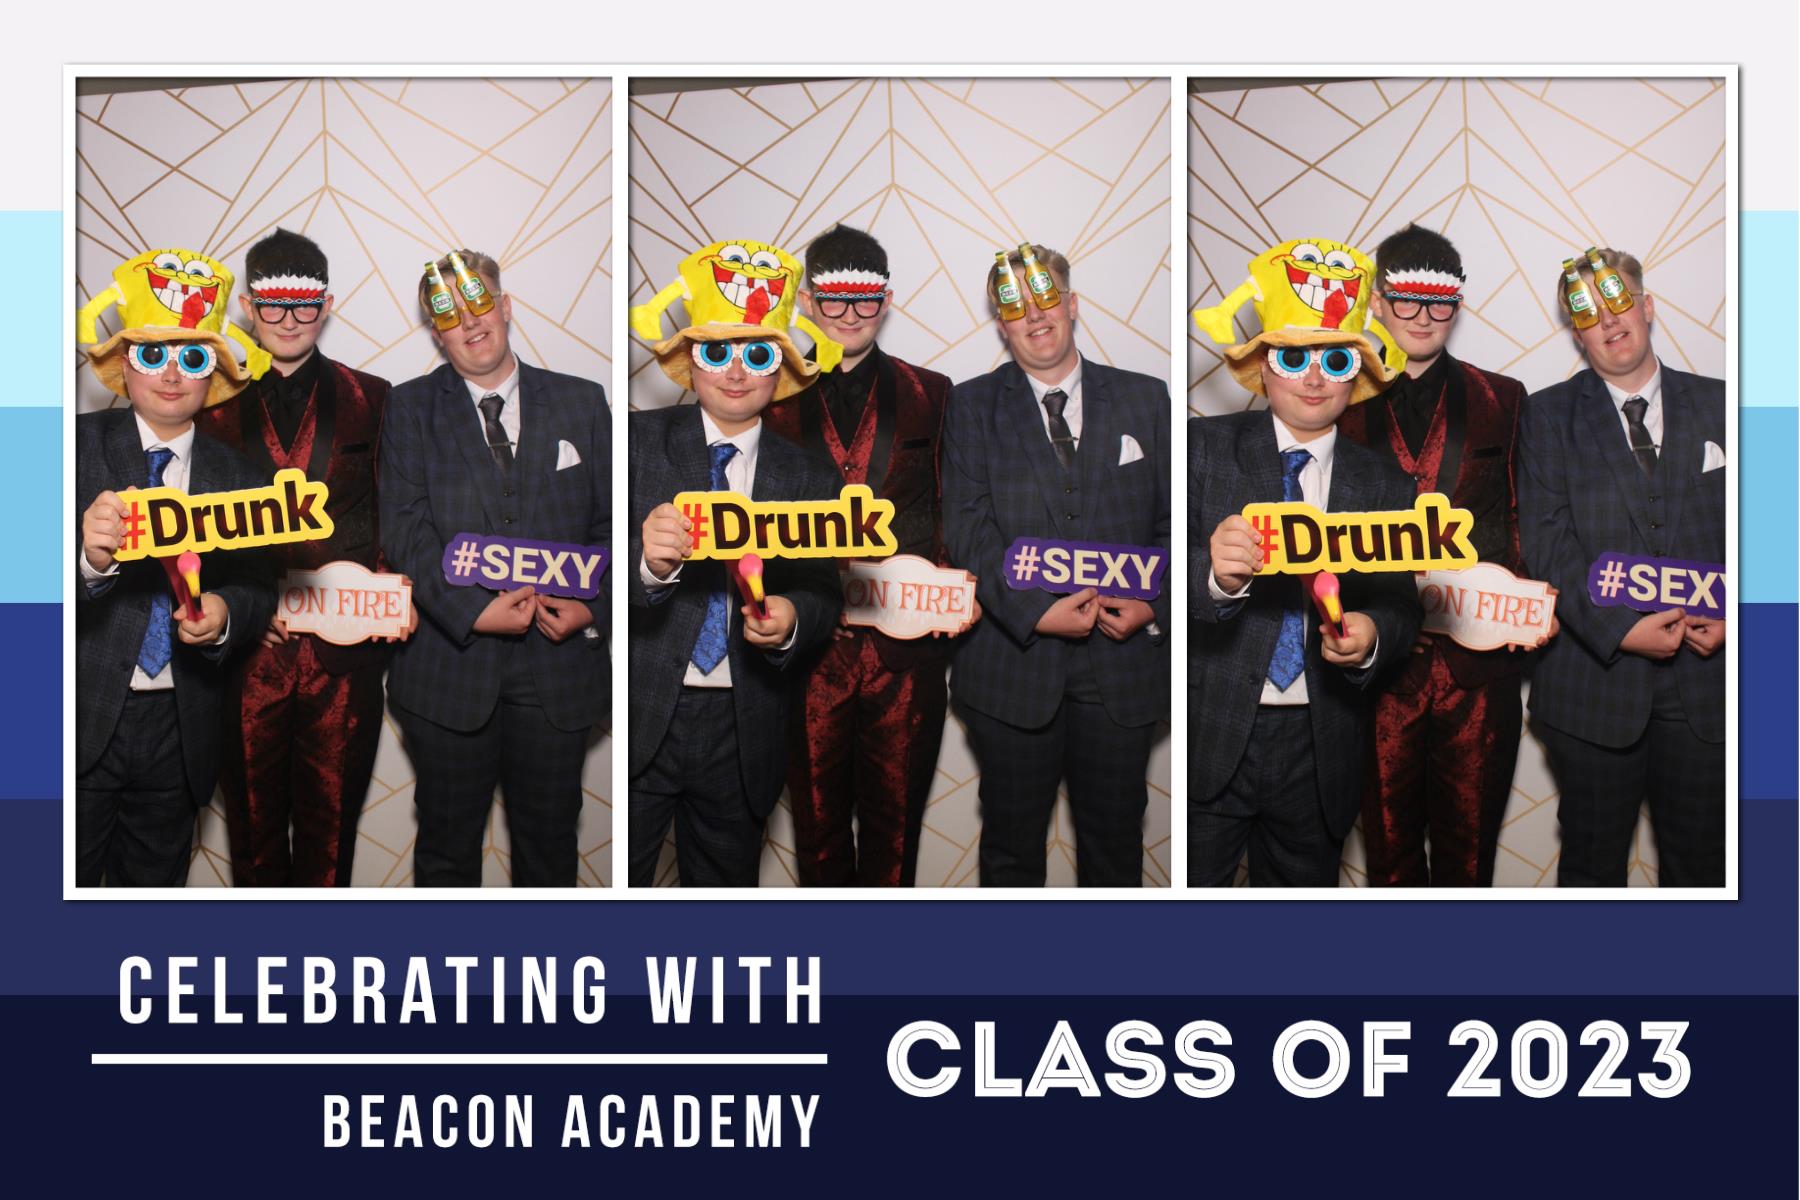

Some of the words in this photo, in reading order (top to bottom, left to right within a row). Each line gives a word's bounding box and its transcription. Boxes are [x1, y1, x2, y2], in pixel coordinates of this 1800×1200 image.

[121, 480, 322, 551] #Drunk
[683, 496, 887, 550] #Drunk
[1252, 506, 1466, 564] #Drunk
[451, 541, 602, 590] #SEXY
[1012, 545, 1162, 591] #SEXY
[1597, 560, 1726, 609] #SEX
[284, 586, 328, 615] ON
[335, 588, 401, 620] FIRE
[845, 578, 890, 608] ON
[898, 582, 965, 616] FIRE
[1421, 584, 1468, 618] ON
[1475, 590, 1544, 627] FIRE
